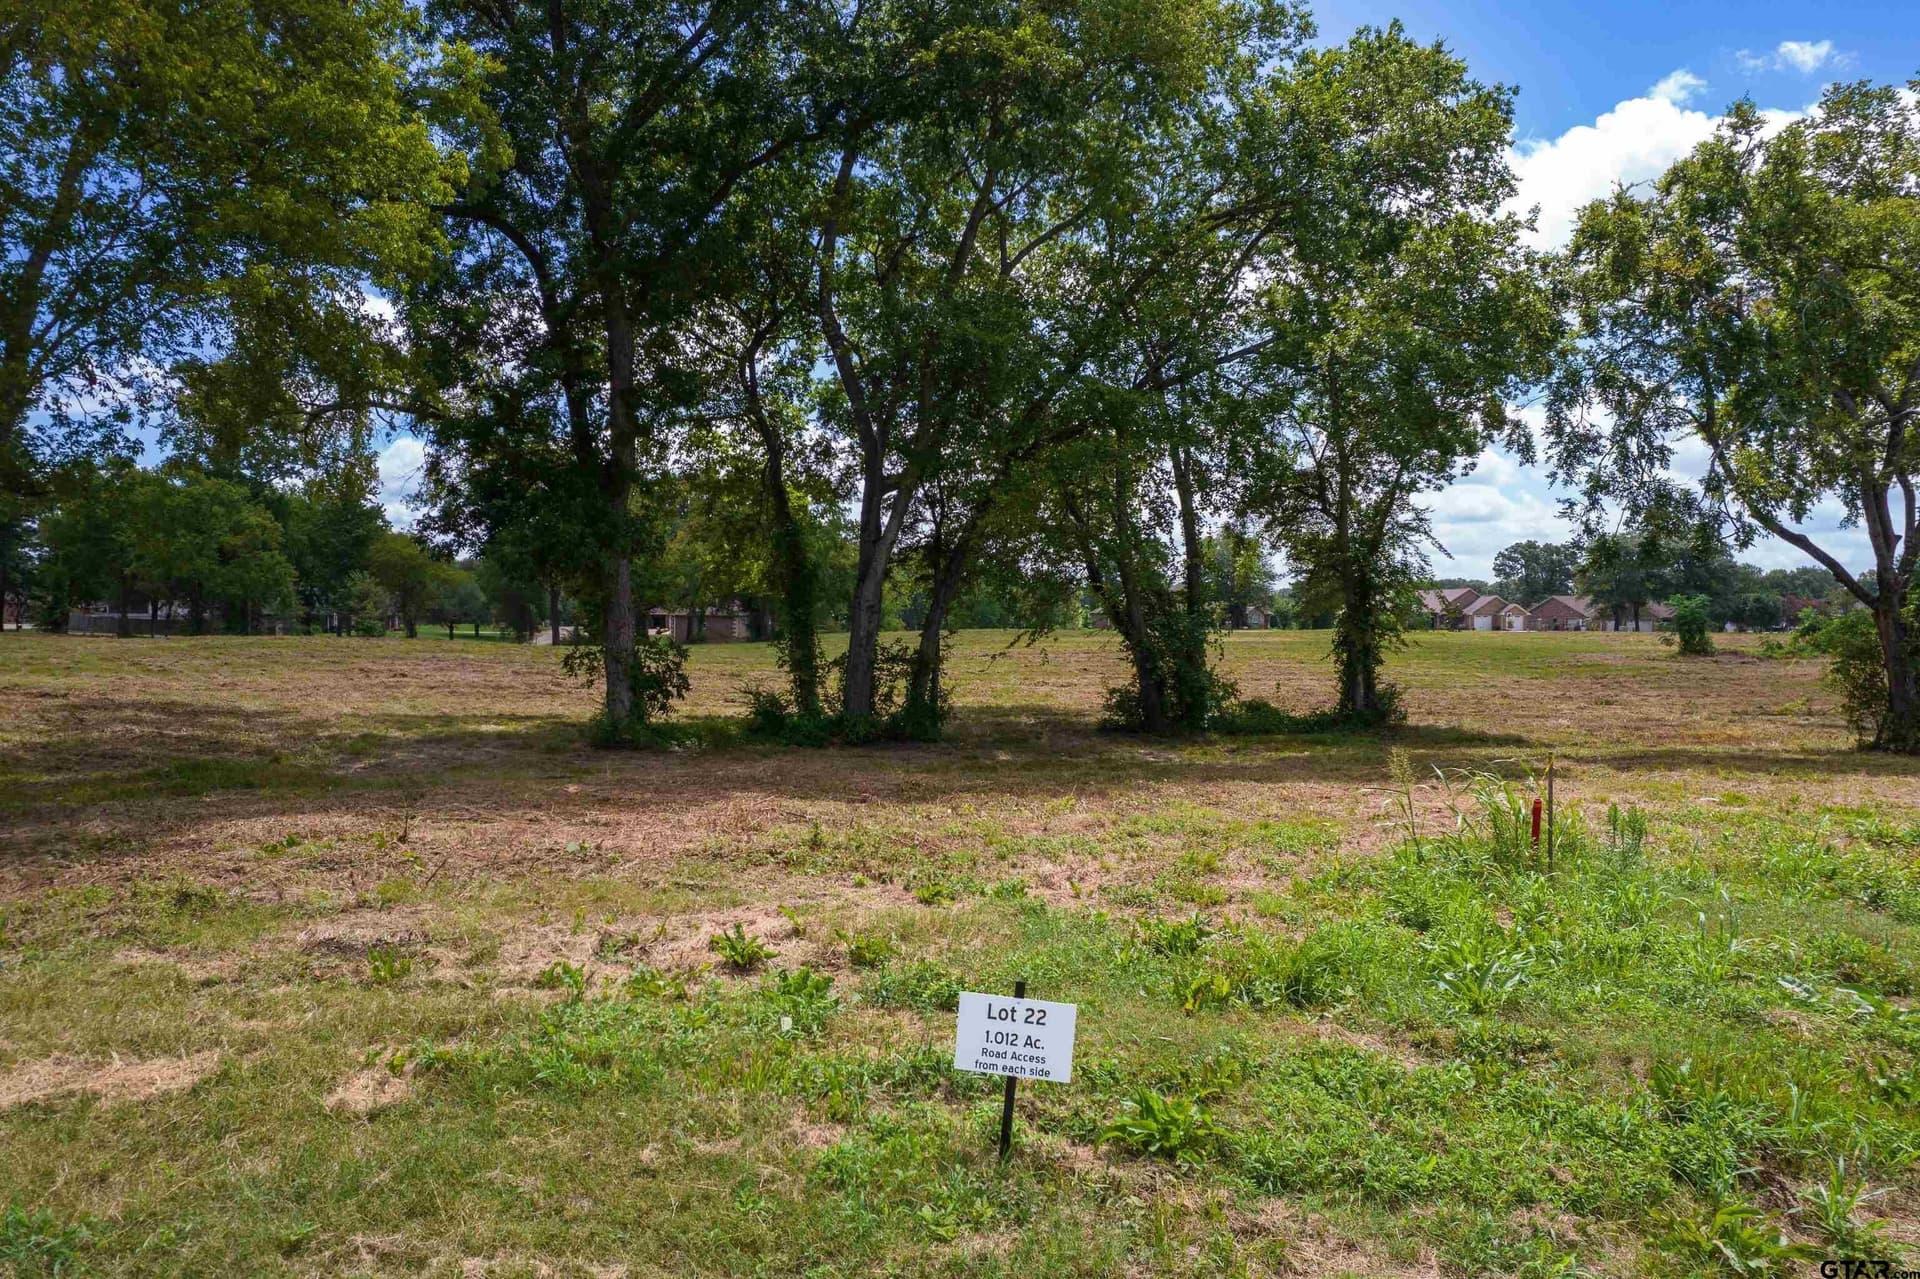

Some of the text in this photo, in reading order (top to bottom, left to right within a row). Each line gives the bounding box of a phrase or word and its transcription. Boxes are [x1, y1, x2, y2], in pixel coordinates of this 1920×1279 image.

[987, 1003, 1047, 1026] Lot 22
[985, 1030, 1045, 1050] 1.012 Ac.
[981, 1047, 1046, 1064] Road Access
[975, 1059, 1051, 1078] from each side
